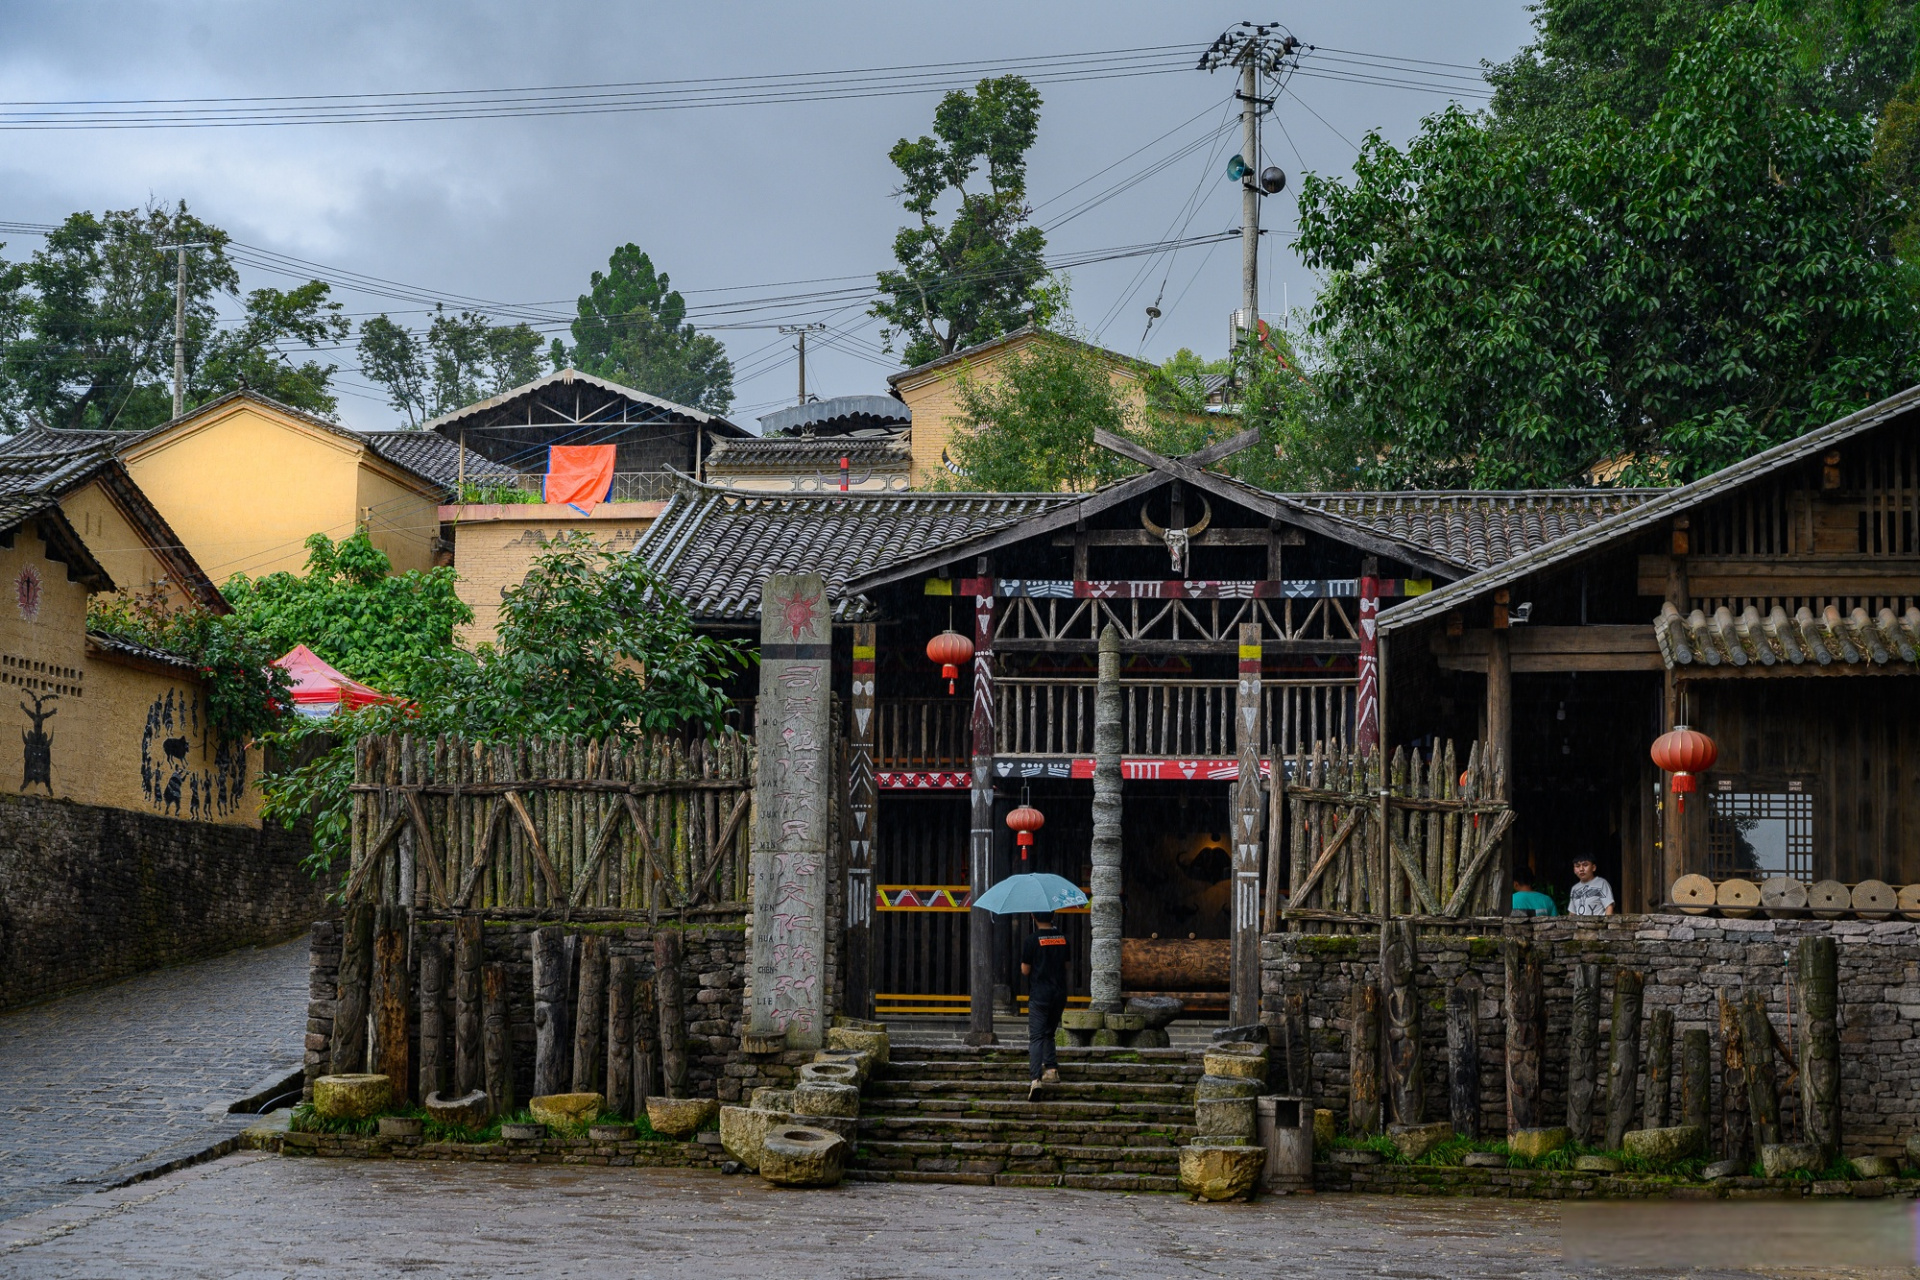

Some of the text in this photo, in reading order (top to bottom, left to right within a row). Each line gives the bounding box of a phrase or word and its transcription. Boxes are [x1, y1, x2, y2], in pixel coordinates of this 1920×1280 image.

[763, 687, 777, 696] SI
[762, 749, 776, 757] LA
[760, 841, 776, 849] MIN
[759, 872, 775, 880] SU
[757, 934, 774, 943] HUA
[757, 966, 775, 974] CHEN
[756, 997, 773, 1006] LIE
